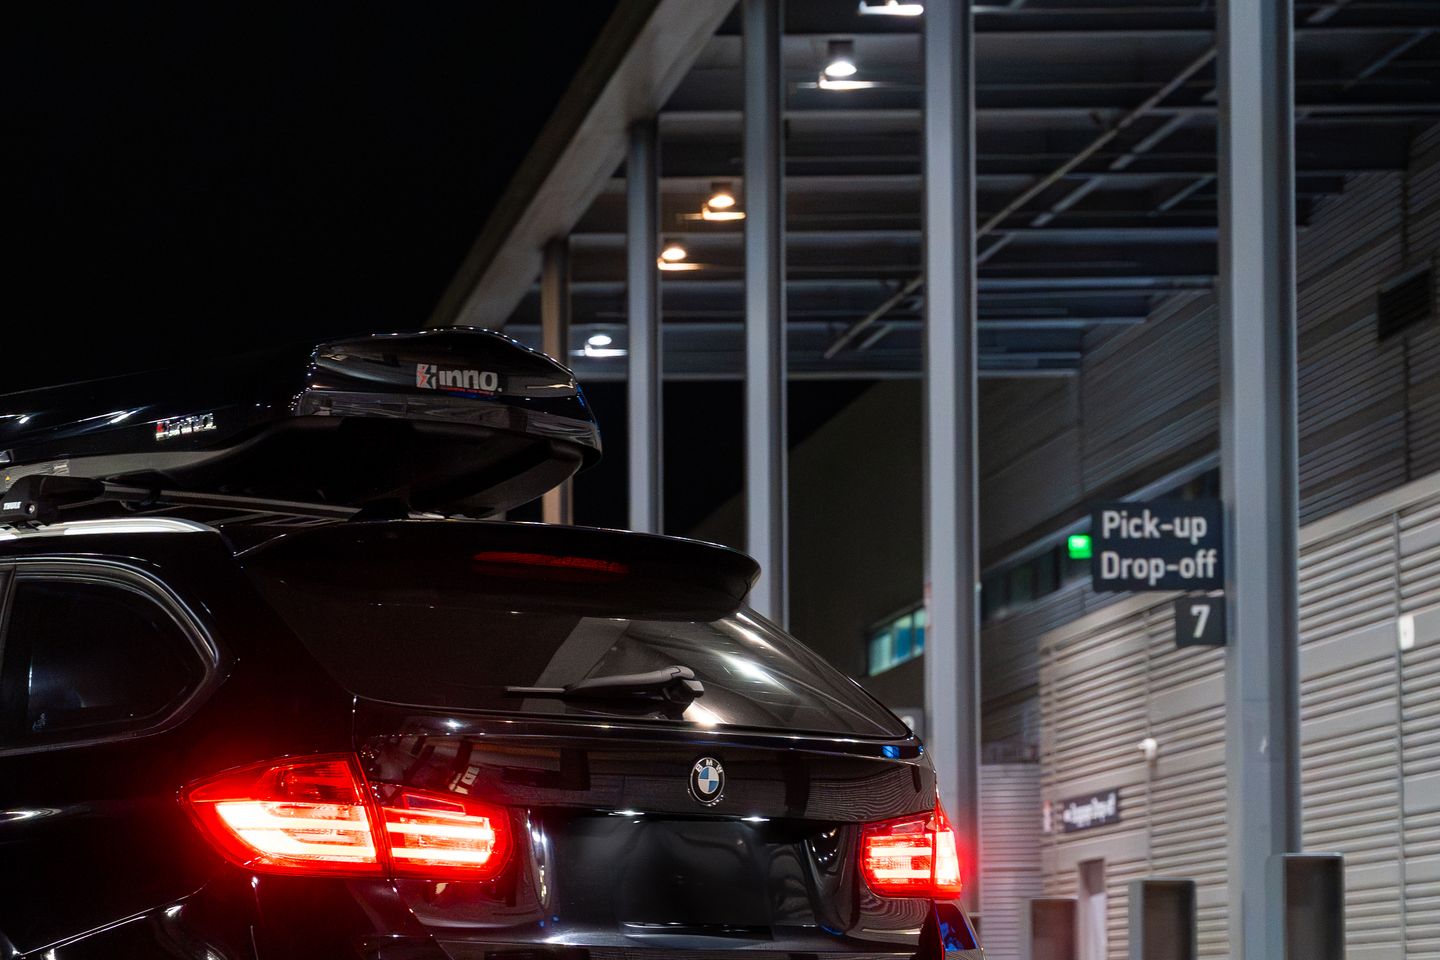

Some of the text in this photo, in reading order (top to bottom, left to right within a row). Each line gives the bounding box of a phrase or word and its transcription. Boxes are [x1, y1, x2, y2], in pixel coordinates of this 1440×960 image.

[1101, 509, 1208, 545] Pick-up
[1100, 548, 1217, 586] Drop-off
[1190, 604, 1210, 638] 7
[695, 759, 723, 774] BMW
